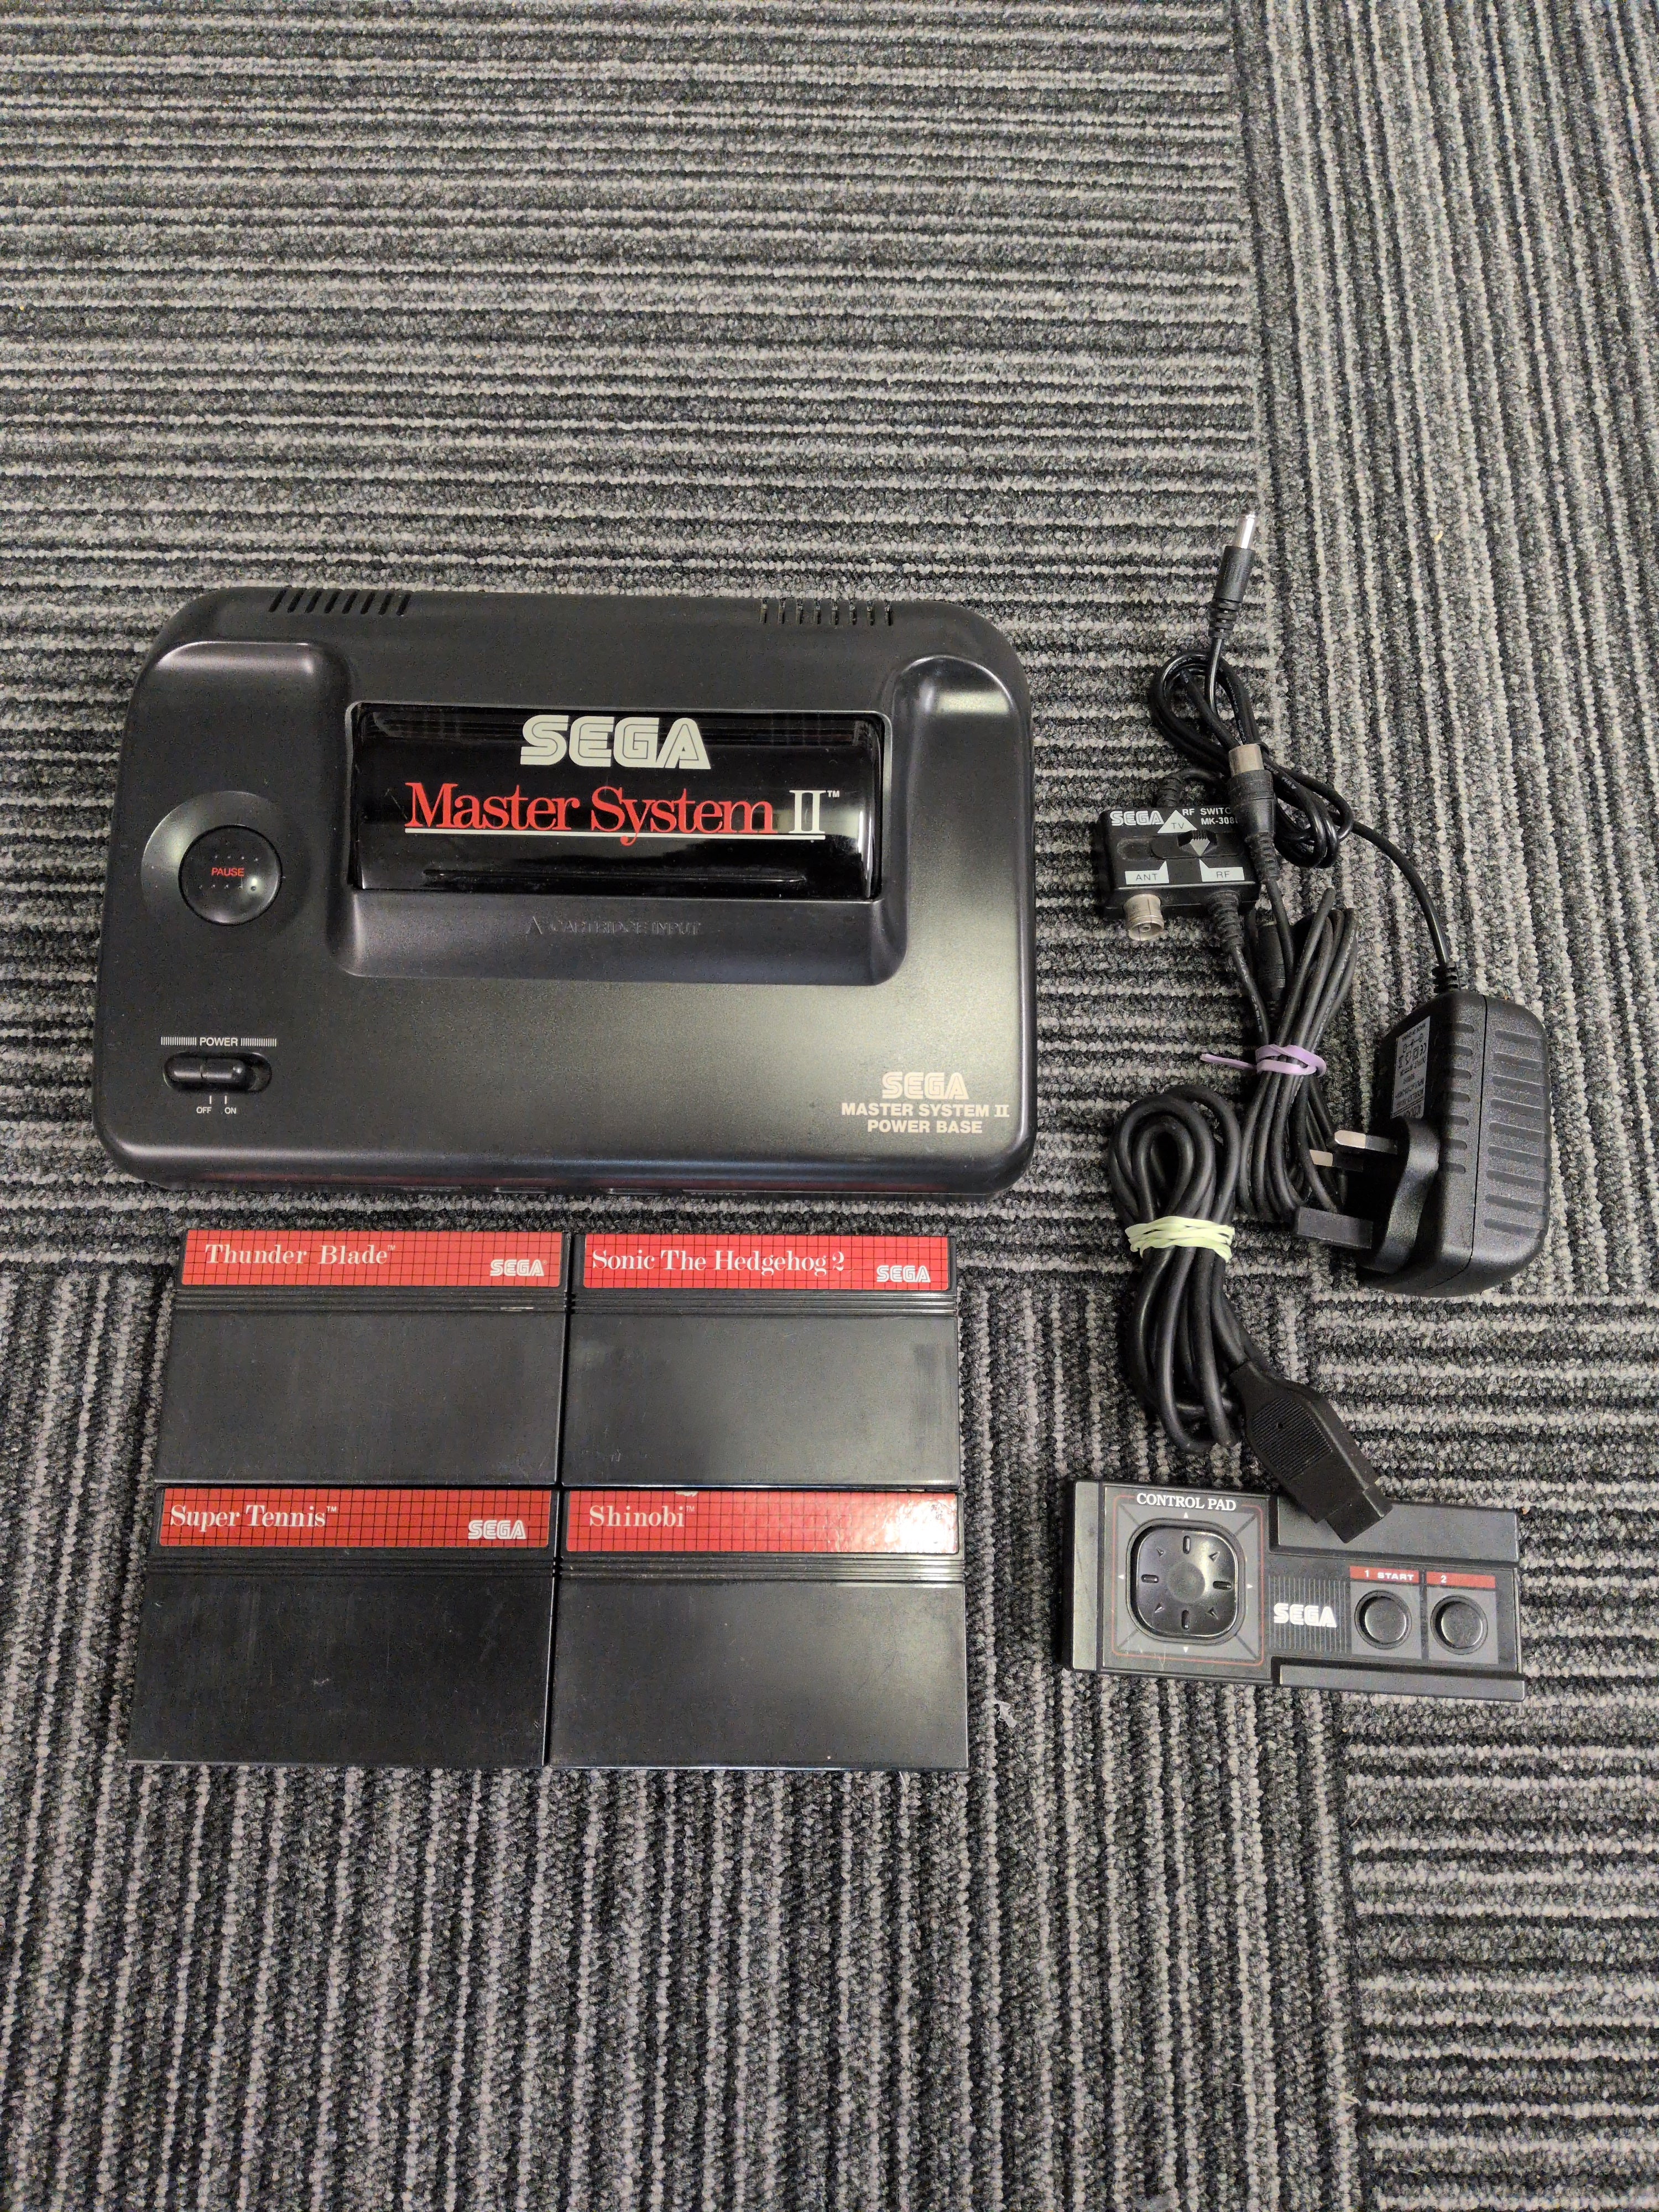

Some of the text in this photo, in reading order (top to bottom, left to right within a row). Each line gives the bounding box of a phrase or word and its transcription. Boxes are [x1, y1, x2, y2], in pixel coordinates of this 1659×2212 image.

[520, 714, 711, 769] SEGA
[405, 782, 580, 832] Master
[591, 786, 773, 846] System
[789, 790, 825, 834] II
[1109, 811, 1165, 826] SEGA
[1200, 807, 1232, 815] SWITC
[211, 867, 244, 877] PAUSE
[199, 1037, 238, 1046] POWER
[881, 1072, 969, 1100] SEGA
[842, 1103, 1010, 1118] MASTER SYSTEM II
[867, 1120, 983, 1133] POWER BASE
[205, 1244, 307, 1265] Thunder
[318, 1245, 388, 1265] Blade
[592, 1249, 845, 1277] Sonic The Hedgehog 2
[490, 1259, 544, 1277] SEGA
[876, 1265, 931, 1283] SEGA
[1136, 1493, 1236, 1512] CONTROL PAD
[170, 1505, 241, 1532] Super
[246, 1504, 326, 1527] Tennis
[589, 1505, 685, 1528] Shinobi
[468, 1519, 526, 1540] SEGA
[1364, 1569, 1415, 1582] 1 START
[1441, 1574, 1447, 1584] 2
[1274, 1603, 1337, 1628] SEGA
